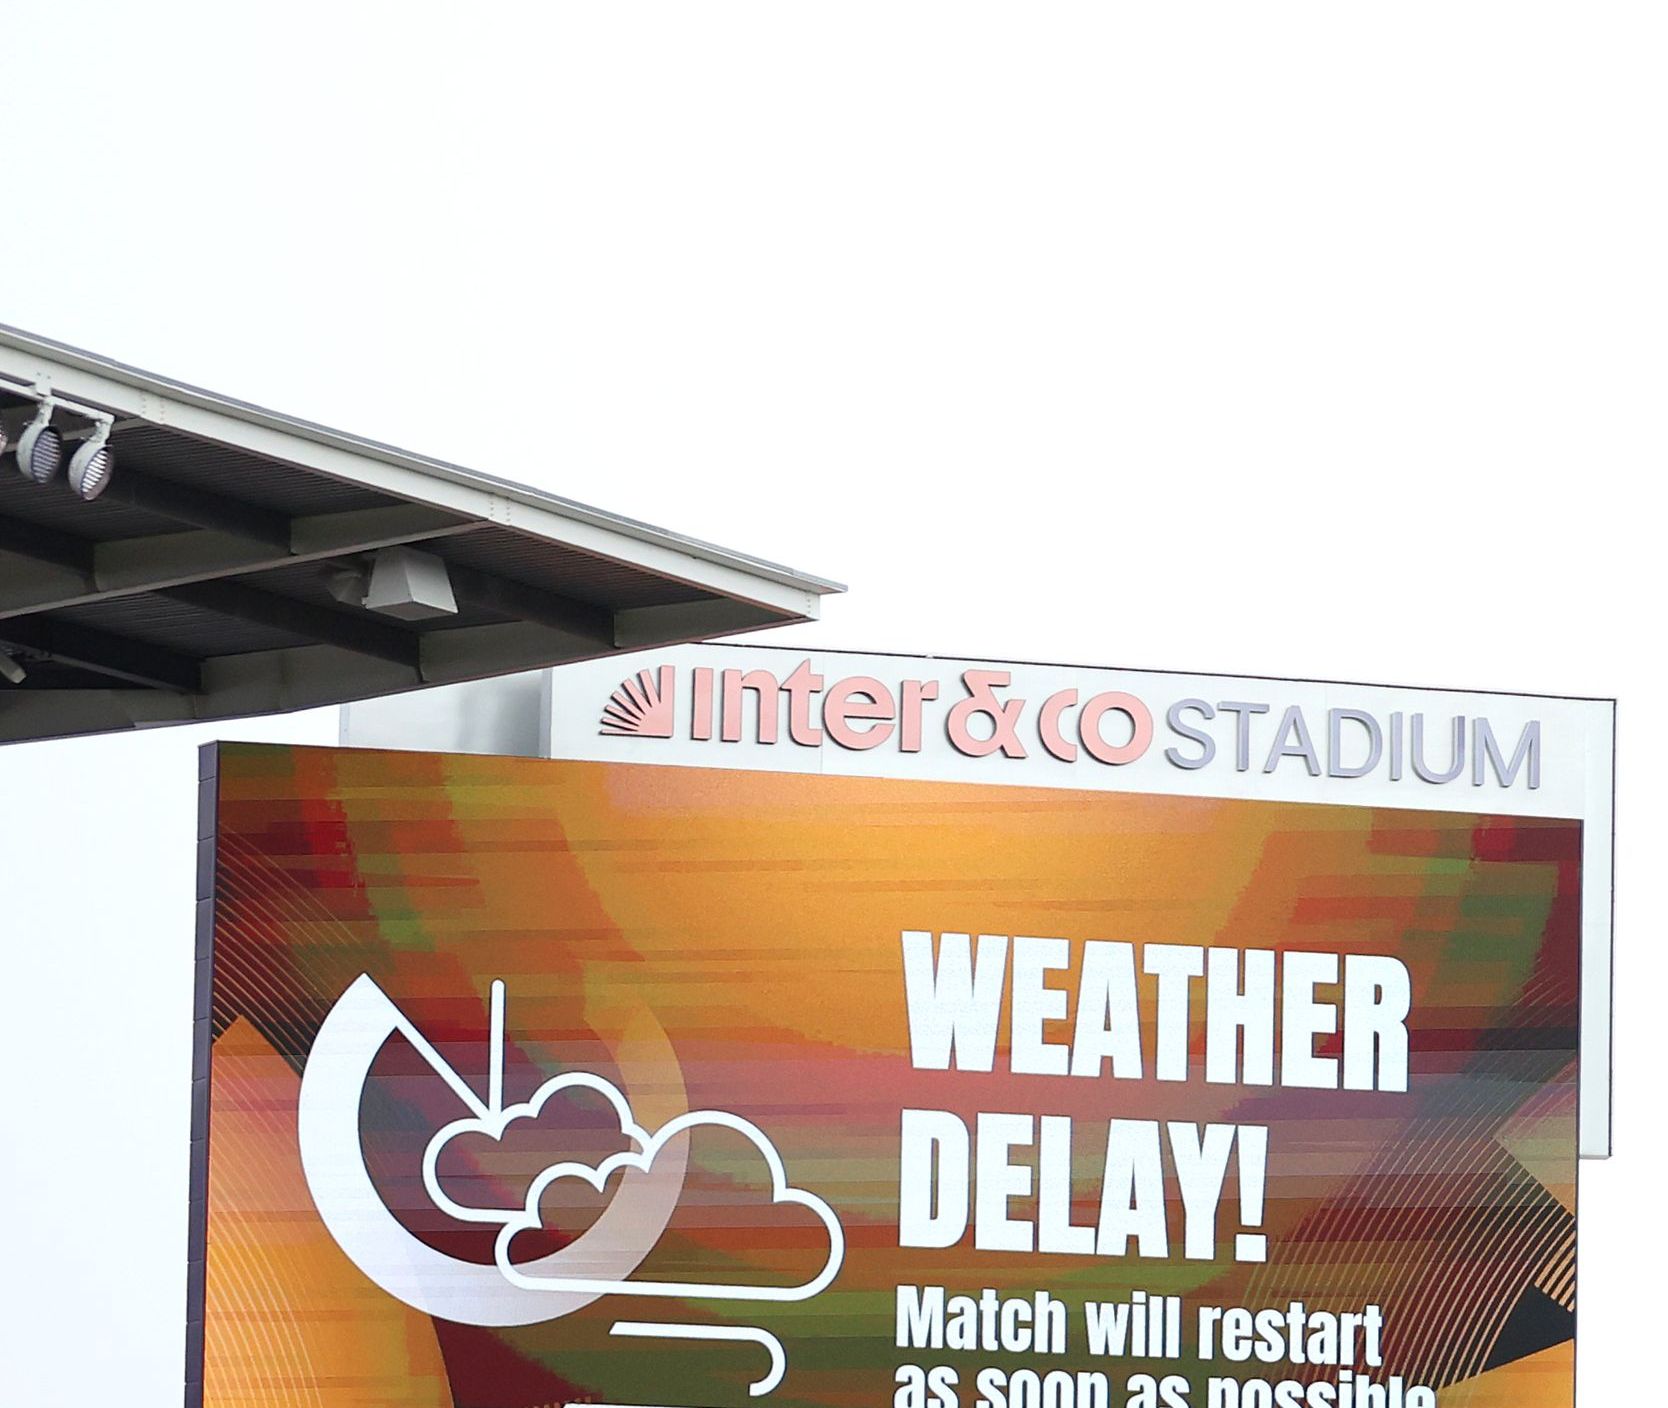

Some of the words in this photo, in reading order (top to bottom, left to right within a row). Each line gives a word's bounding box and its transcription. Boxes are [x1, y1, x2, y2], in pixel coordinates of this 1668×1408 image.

[1165, 697, 1542, 790] STADIUM
[900, 930, 1412, 1093] WEATHER
[898, 1108, 1269, 1262] DELAY!
[895, 1285, 1067, 1355] Match
[1084, 1290, 1182, 1359] will
[1197, 1301, 1384, 1367] restart
